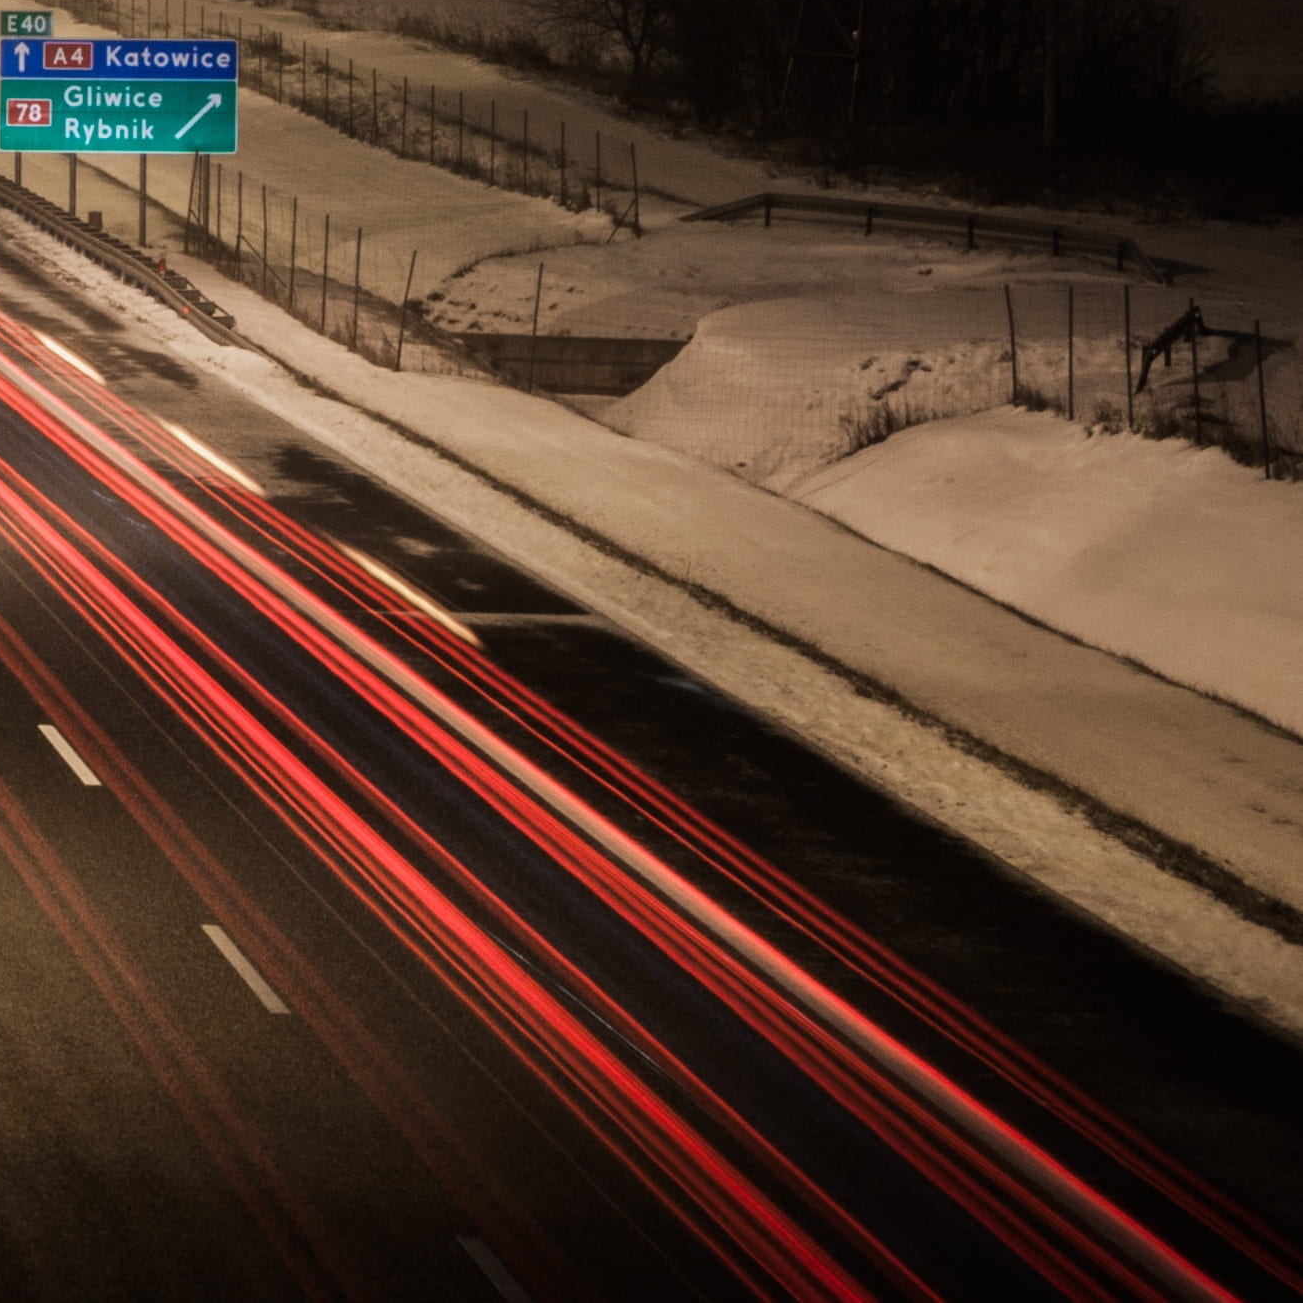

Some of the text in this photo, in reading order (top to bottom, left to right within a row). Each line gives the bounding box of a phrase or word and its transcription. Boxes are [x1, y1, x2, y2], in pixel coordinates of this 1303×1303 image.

[52, 45, 232, 69] A4 Katowice
[63, 85, 164, 108] Gliwice
[15, 103, 43, 123] 78
[64, 117, 155, 145] Rybnik
